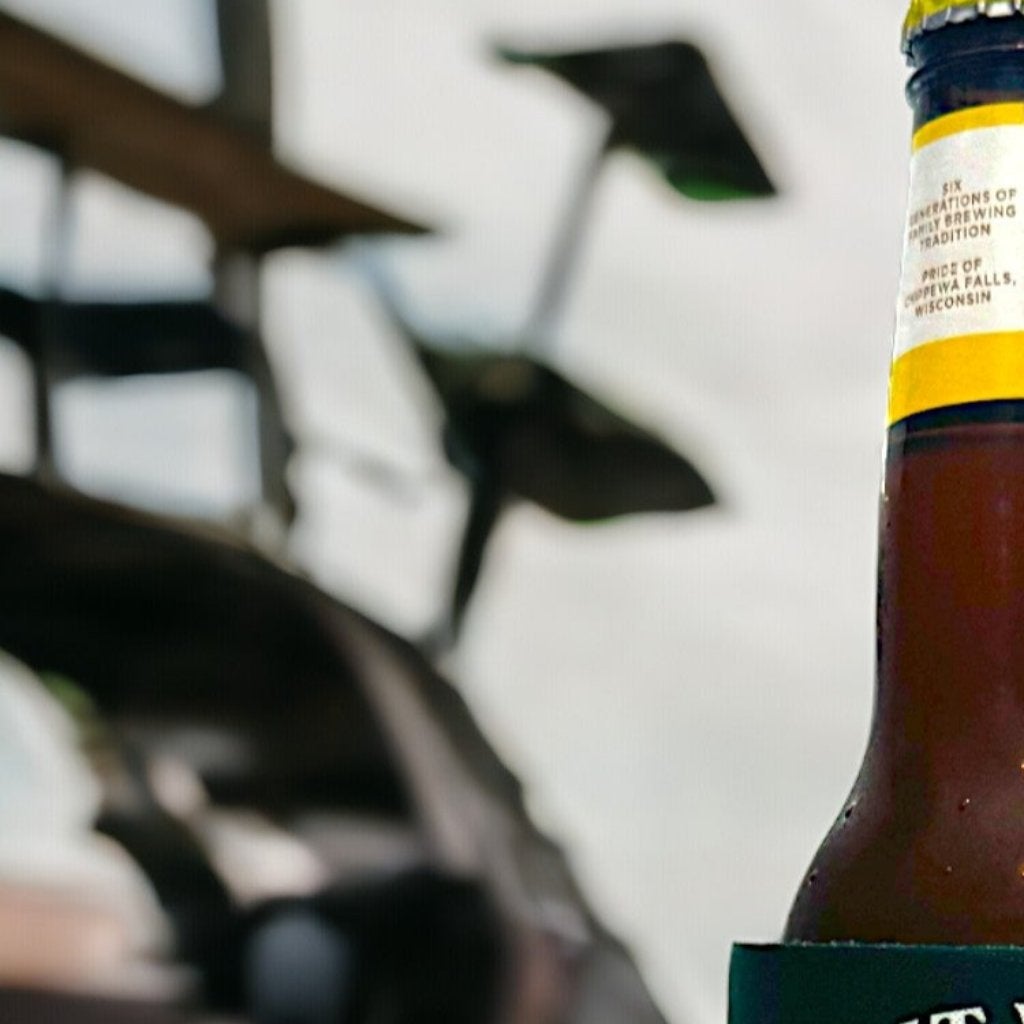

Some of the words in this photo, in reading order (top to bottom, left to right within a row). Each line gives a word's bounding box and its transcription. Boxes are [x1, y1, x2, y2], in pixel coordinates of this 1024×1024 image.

[943, 179, 962, 196] SIX
[995, 188, 1017, 202] OF
[944, 204, 1017, 229] BREWING
[919, 223, 991, 252] TRADITION
[922, 262, 958, 283] PRIDE
[962, 257, 982, 274] OF
[964, 272, 1017, 290] FALLS,
[914, 290, 992, 318] WISCONSIN
